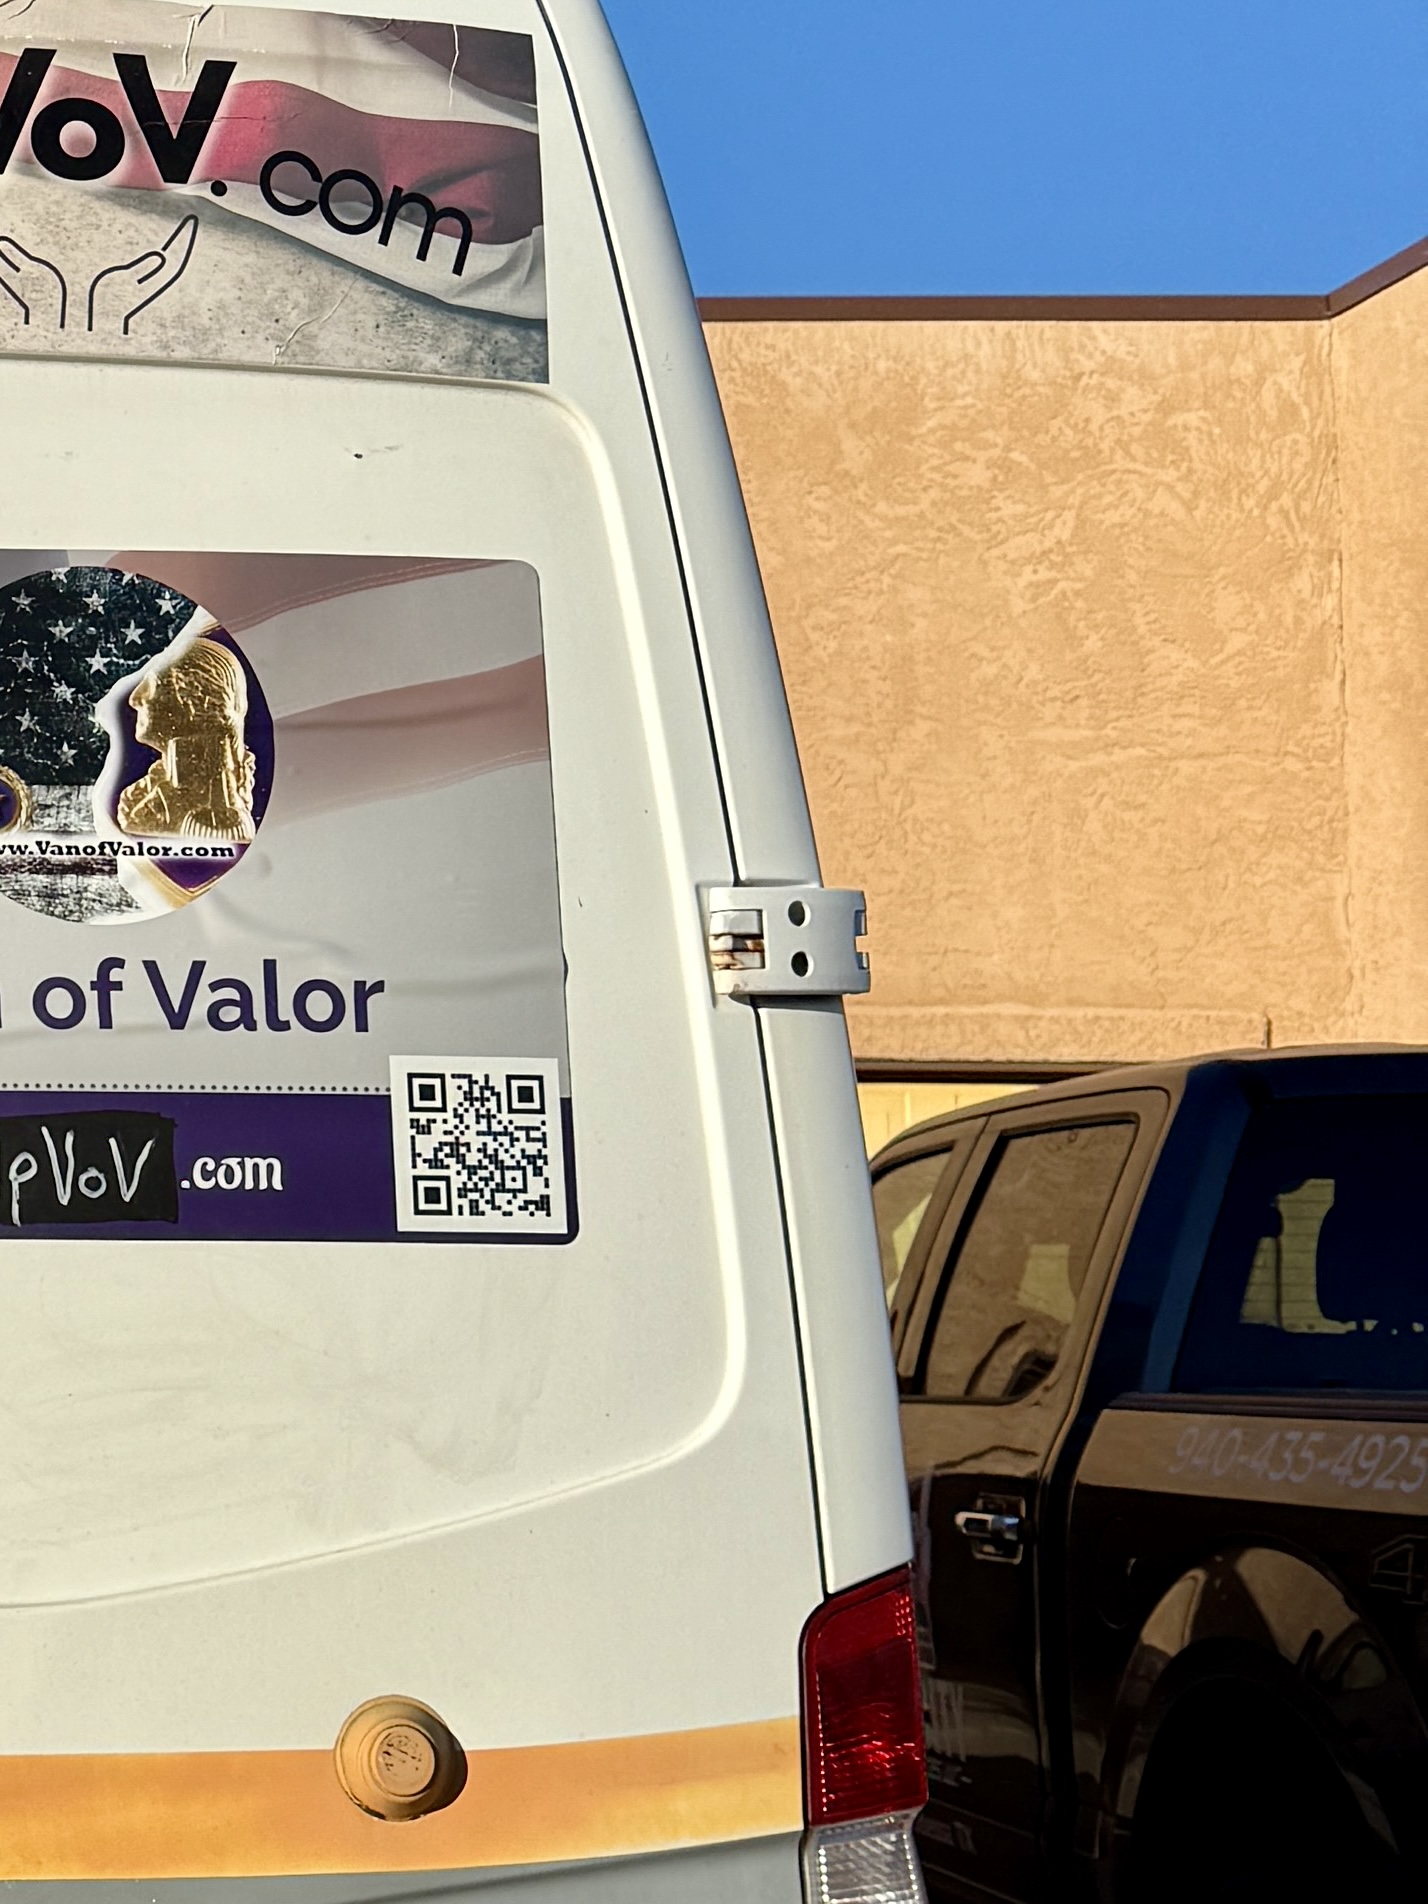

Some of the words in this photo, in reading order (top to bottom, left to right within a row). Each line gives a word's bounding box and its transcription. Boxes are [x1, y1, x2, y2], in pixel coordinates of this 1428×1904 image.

[32, 957, 124, 1031] of
[142, 959, 386, 1035] Valor
[1169, 1427, 1428, 1492] 940-435-4925
